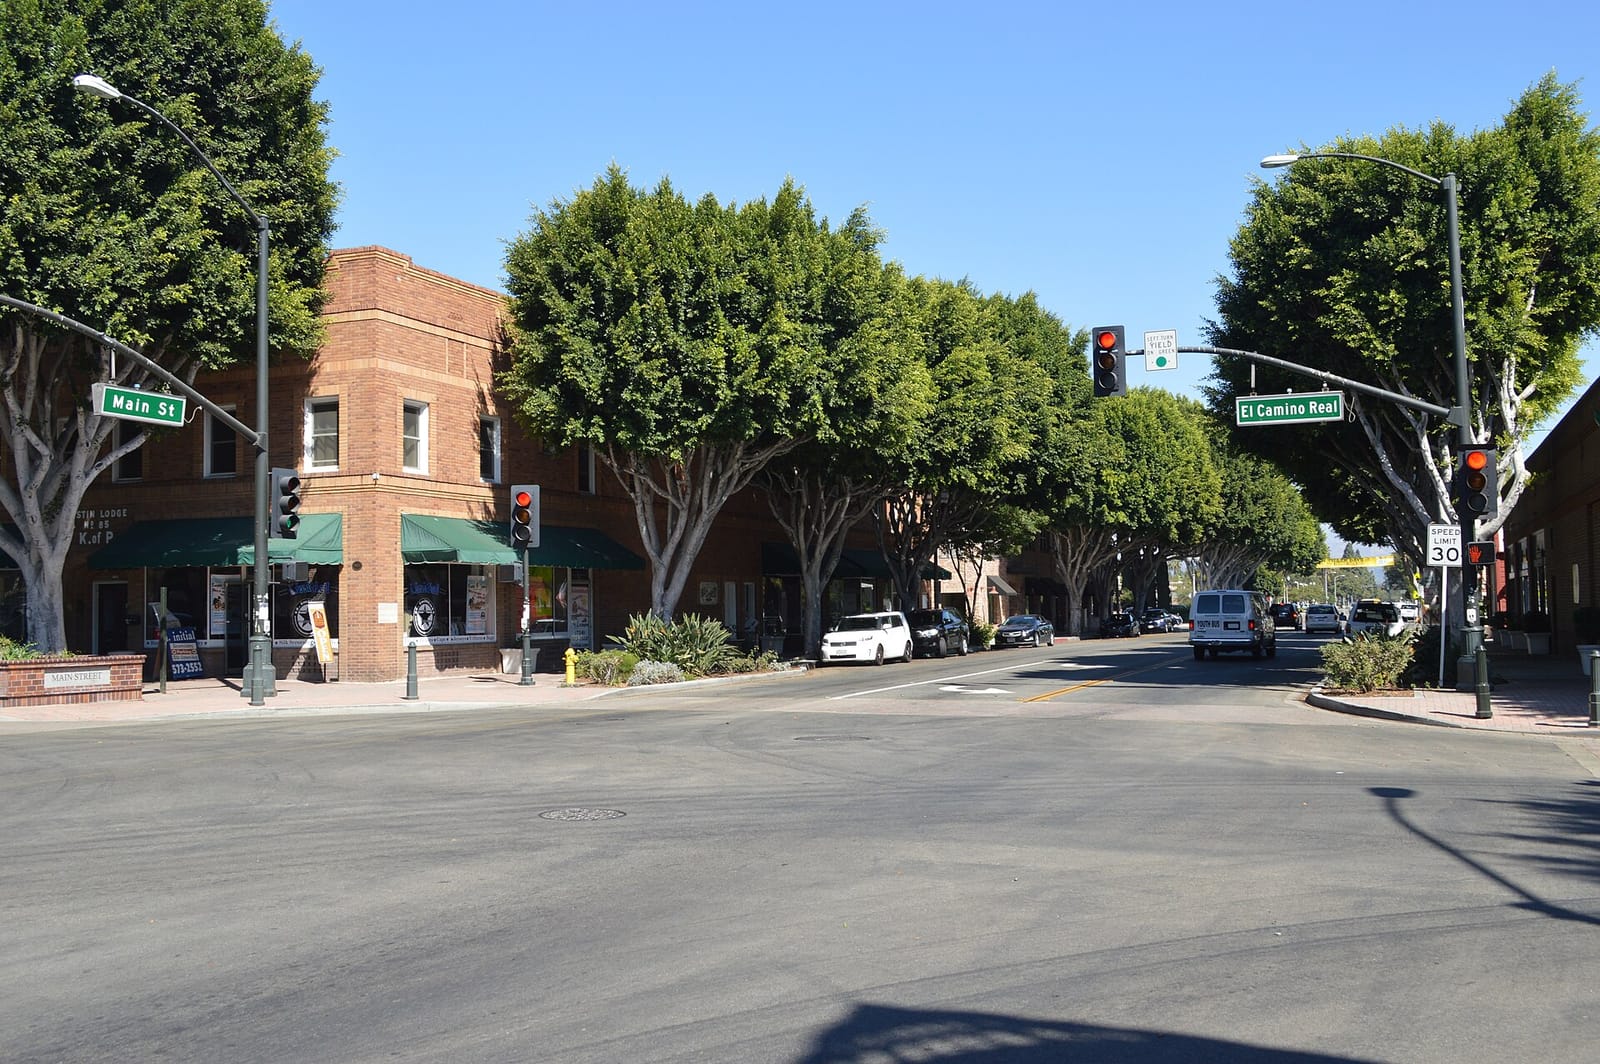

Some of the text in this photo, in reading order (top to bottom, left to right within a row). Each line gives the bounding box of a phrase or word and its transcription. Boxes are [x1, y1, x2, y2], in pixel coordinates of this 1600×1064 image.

[1150, 340, 1172, 349] YIELD
[112, 394, 175, 417] Main St
[1241, 400, 1338, 418] El Camino Real
[76, 508, 128, 519] STIN LODGE
[105, 531, 114, 544] P
[1431, 528, 1461, 536] SPEED
[1434, 537, 1457, 545] LIMIT
[1431, 547, 1459, 562] 30
[172, 630, 196, 642] initial
[74, 672, 102, 681] STREET
